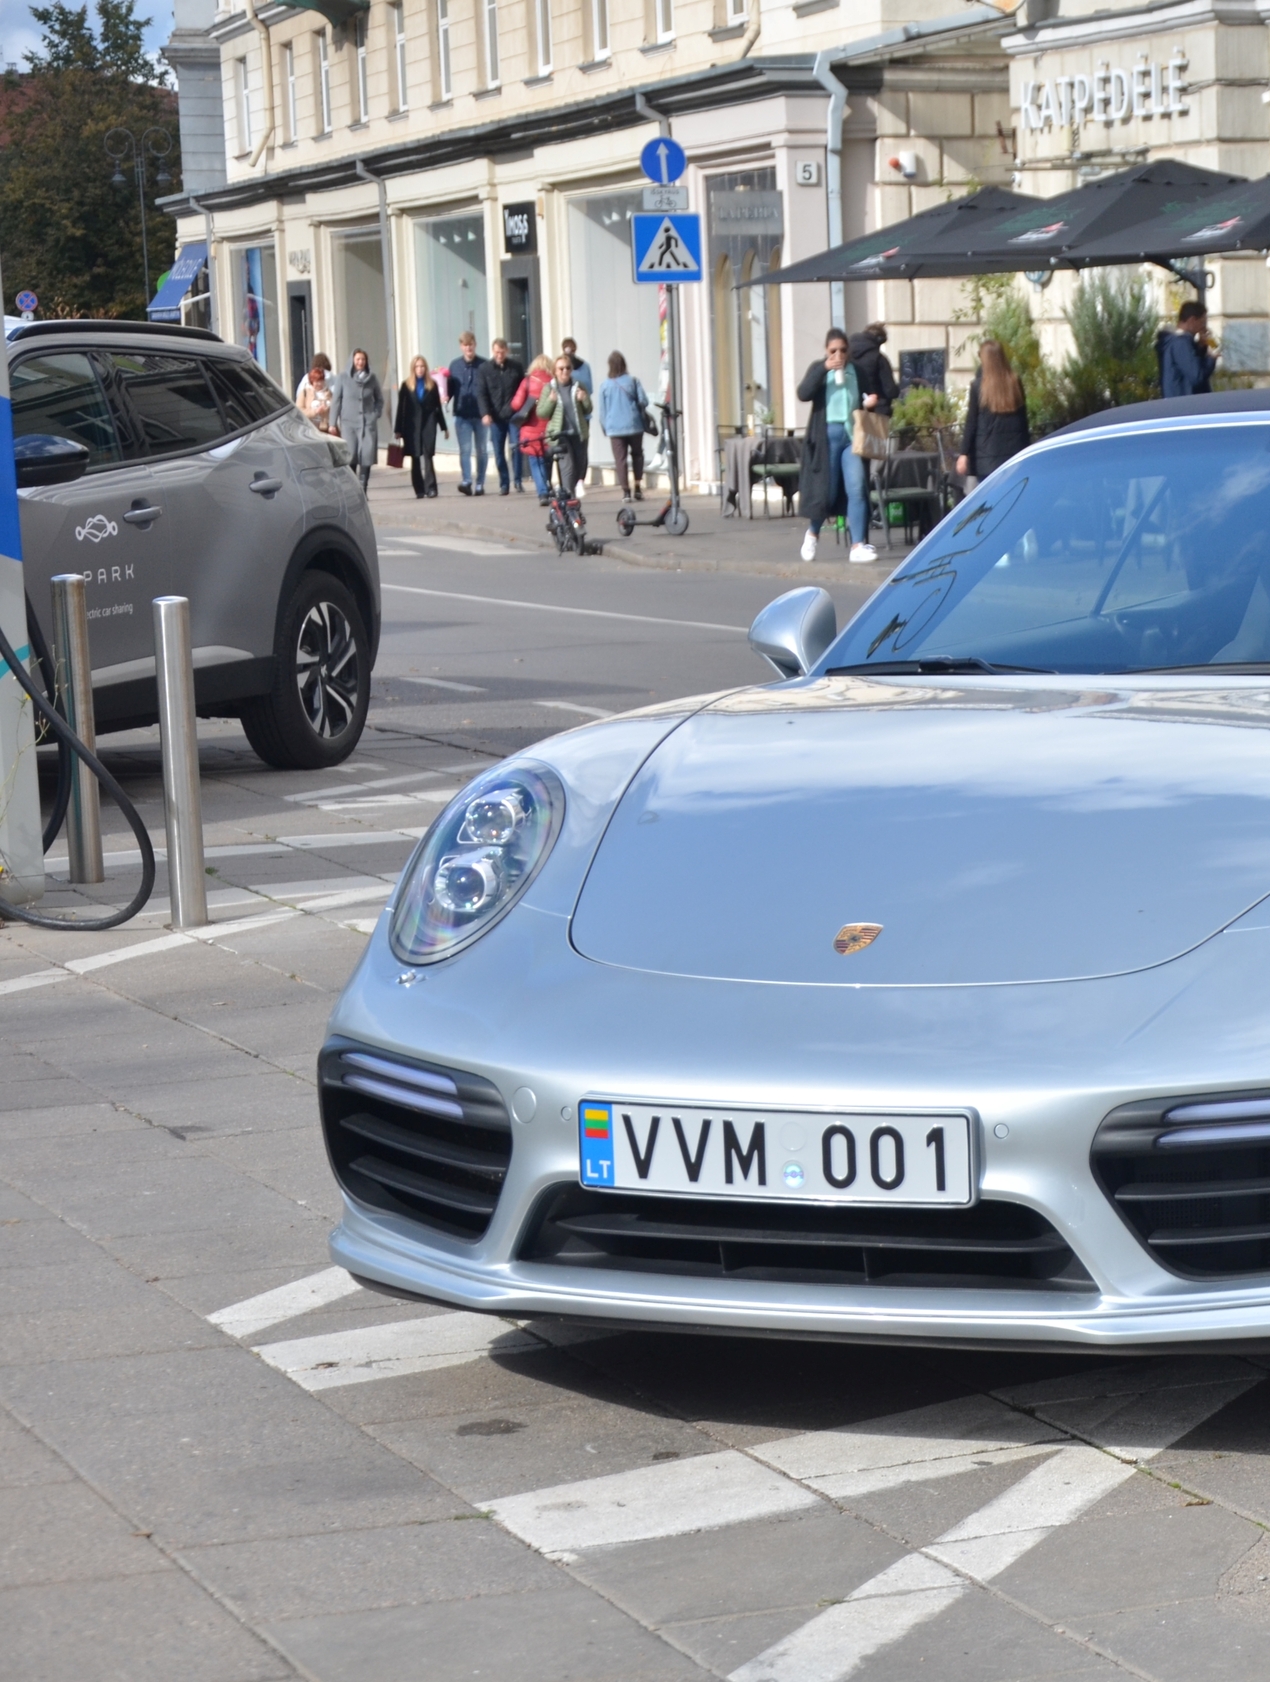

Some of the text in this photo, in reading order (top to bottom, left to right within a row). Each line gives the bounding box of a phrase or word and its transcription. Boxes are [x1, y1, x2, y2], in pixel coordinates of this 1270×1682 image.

[1020, 45, 1188, 130] KATPĖDĖLĖ
[802, 164, 813, 181] 5
[72, 563, 134, 586] PARK
[102, 607, 112, 617] car
[112, 602, 133, 615] sharing
[622, 1113, 947, 1192] VVM 001
[586, 1159, 611, 1180] LT
